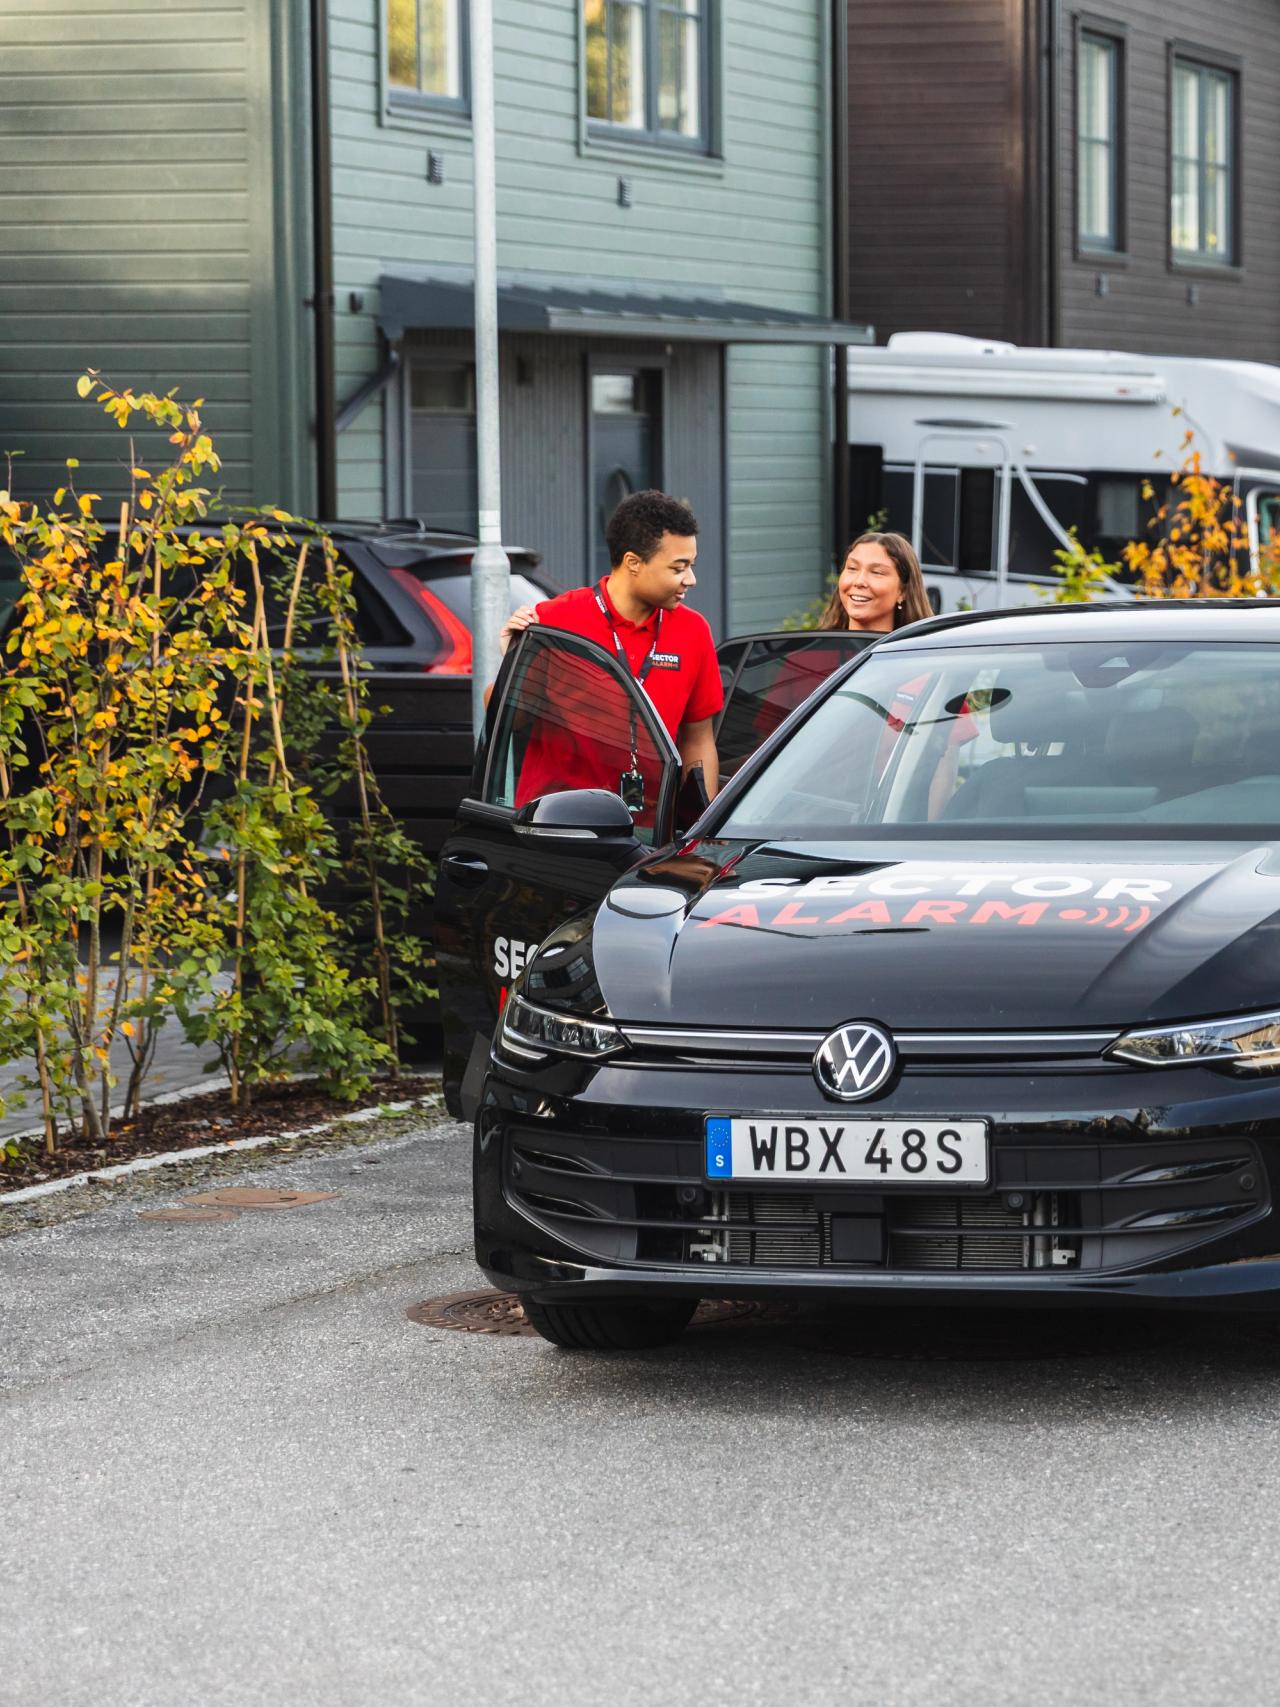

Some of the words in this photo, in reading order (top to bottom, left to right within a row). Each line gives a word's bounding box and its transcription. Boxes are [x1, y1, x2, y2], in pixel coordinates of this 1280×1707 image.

[725, 874, 1174, 902] SECTOR
[697, 900, 1052, 929] ALARM
[715, 1155, 725, 1168] S
[749, 1126, 847, 1173] WBX
[864, 1128, 963, 1174] 48S
